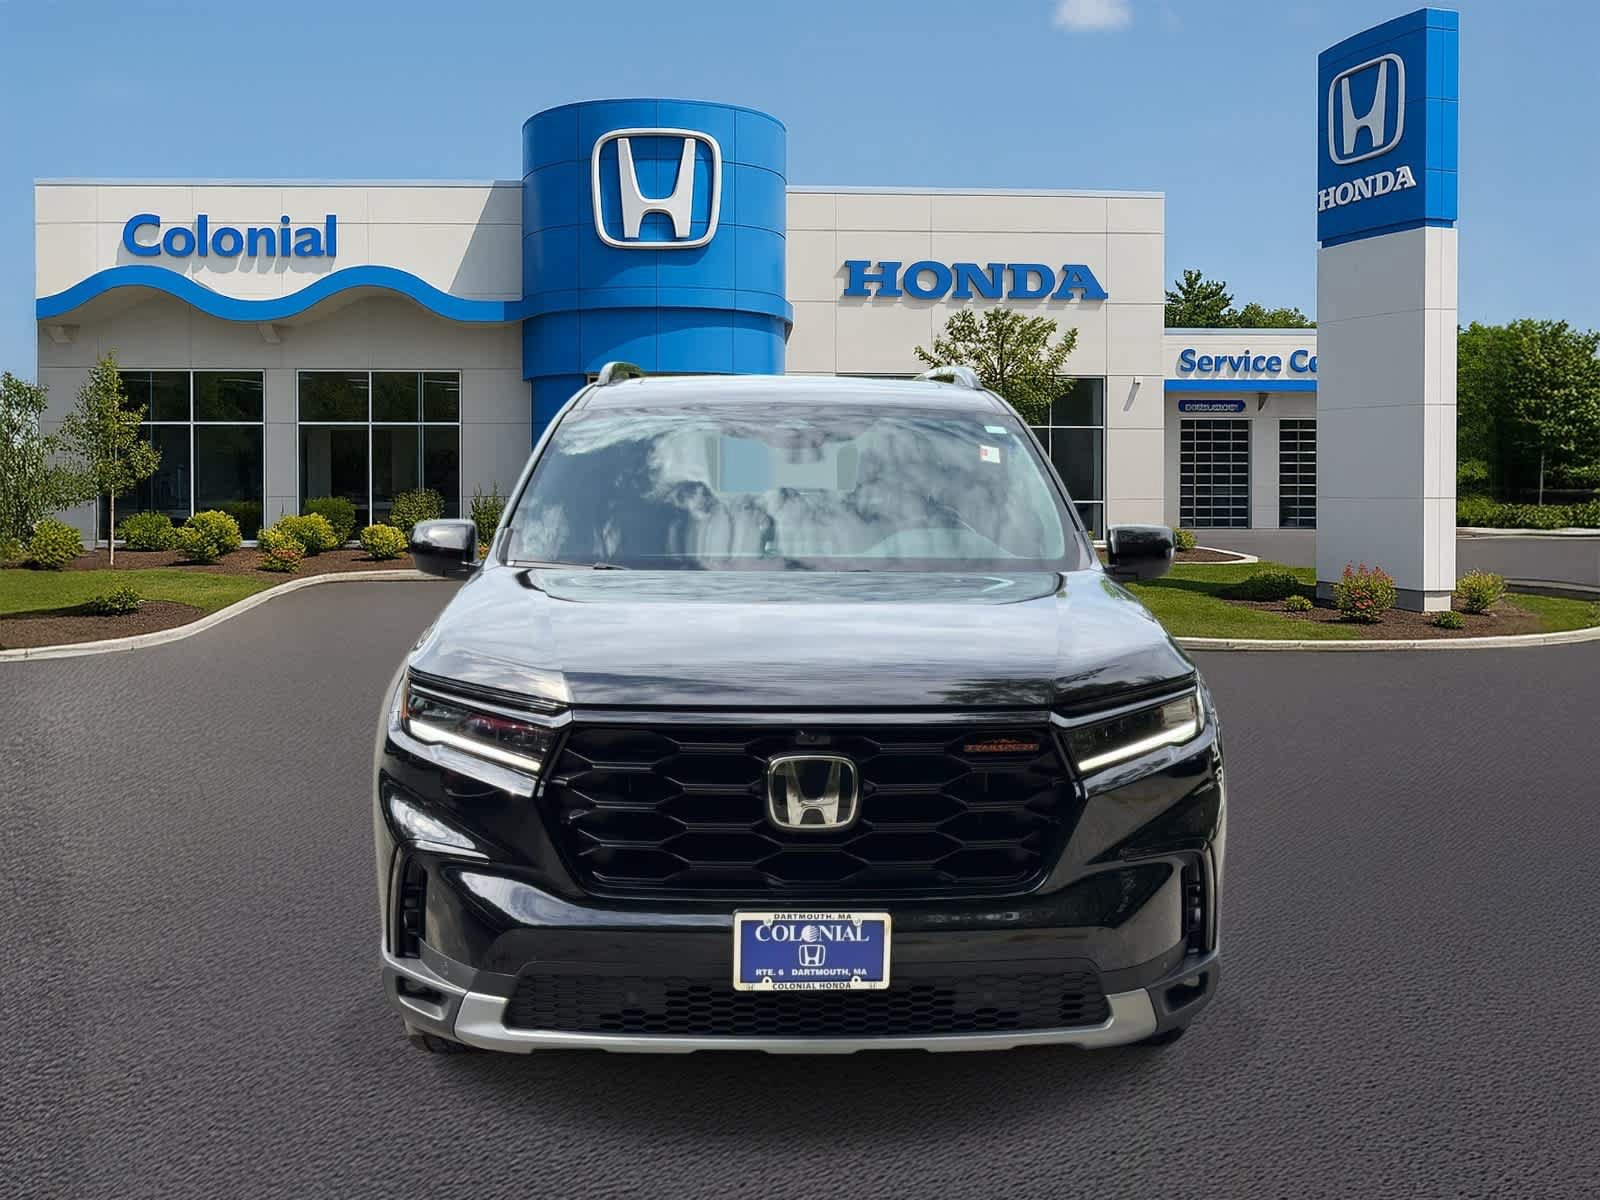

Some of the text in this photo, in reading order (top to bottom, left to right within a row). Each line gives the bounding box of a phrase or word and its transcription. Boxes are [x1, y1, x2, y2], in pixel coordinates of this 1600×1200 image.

[1318, 165, 1416, 211] HONDA
[122, 213, 337, 257] Colonial
[843, 260, 1109, 300] HONDA
[1180, 349, 1282, 372] Service
[755, 924, 870, 942] COLONIAL
[755, 968, 868, 977] RTE. 6 DARTMOUTH, MA
[772, 982, 852, 991] COLONIAL HONDA
